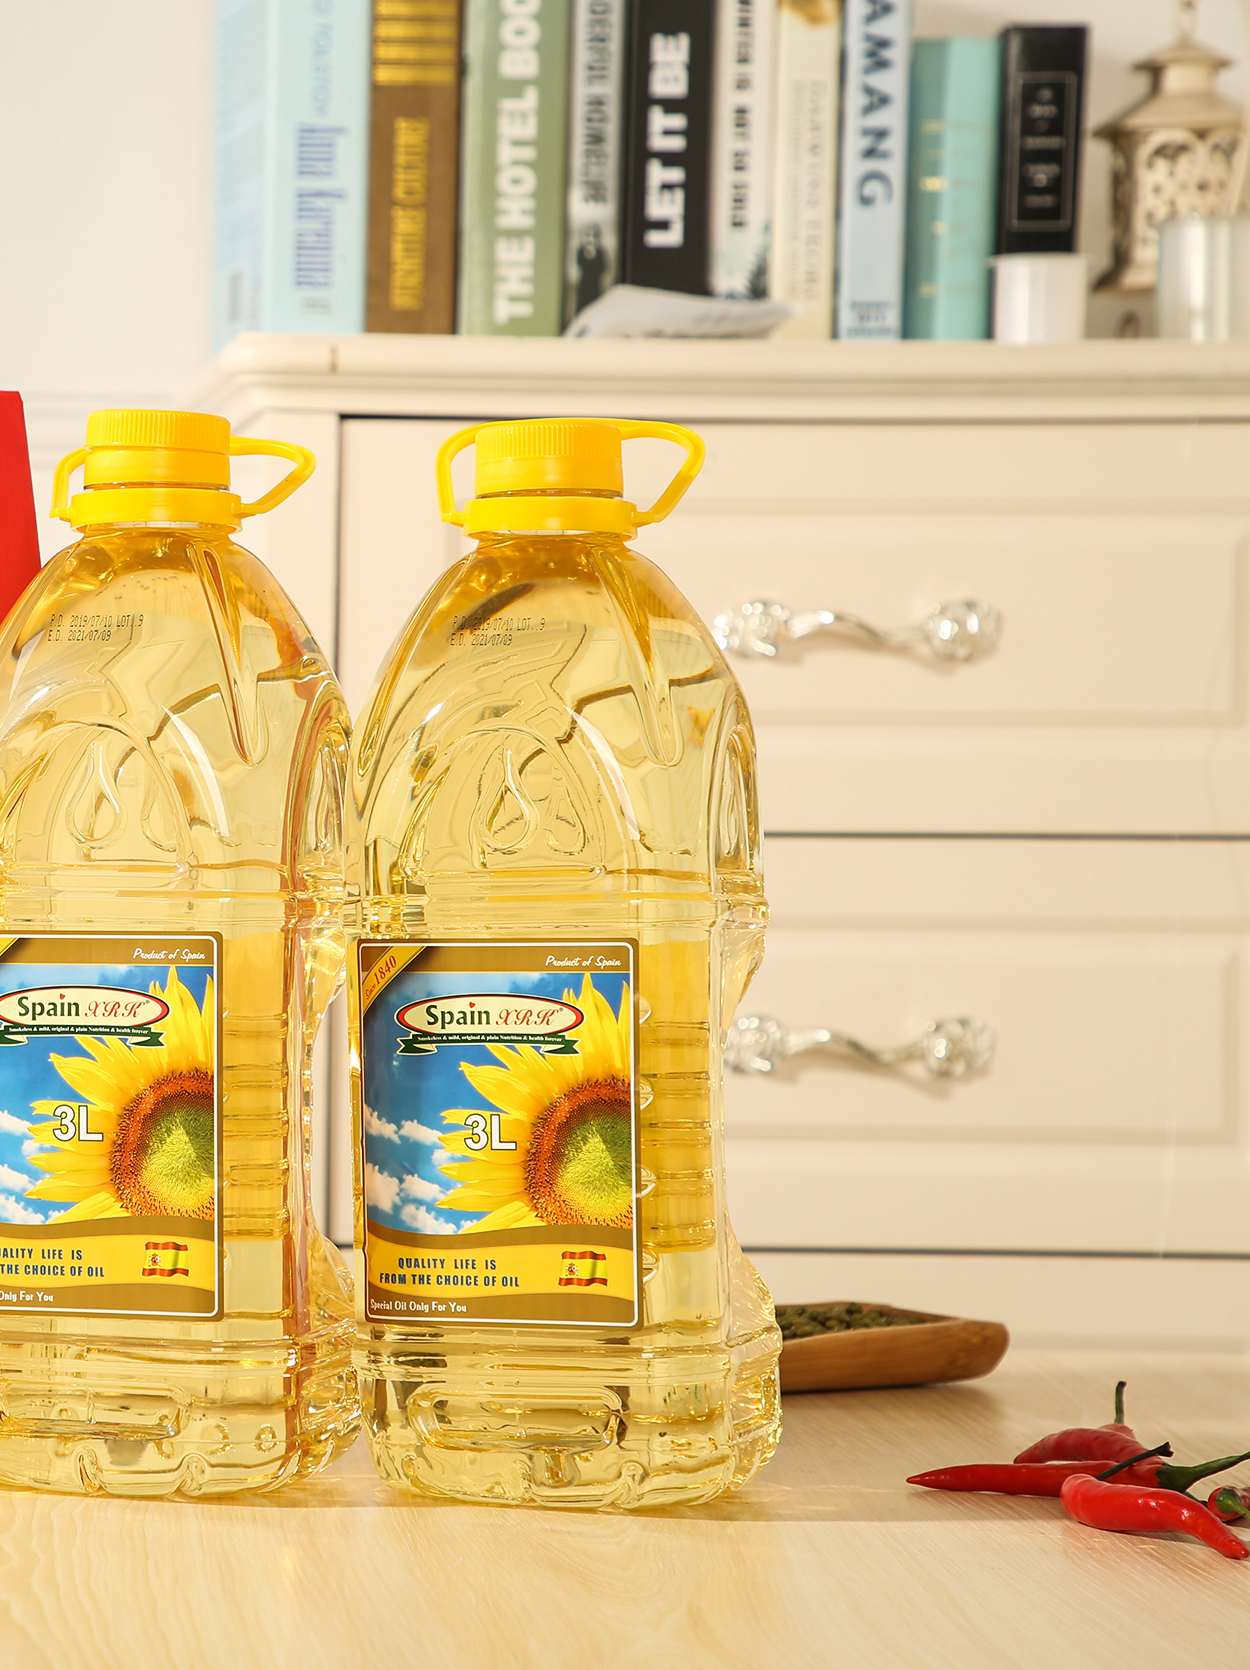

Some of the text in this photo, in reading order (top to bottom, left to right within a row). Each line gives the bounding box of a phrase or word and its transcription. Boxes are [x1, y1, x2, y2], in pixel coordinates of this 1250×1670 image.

[643, 31, 691, 248] LET IT BE
[495, 85, 539, 230] HOTEL
[493, 235, 535, 325] THE
[133, 948, 206, 963] Product of Spain
[545, 955, 622, 970] Product of Spain
[373, 954, 398, 985] 1840
[17, 993, 80, 1021] Spain
[425, 1002, 491, 1030] Spain
[52, 1105, 104, 1142] 3L
[463, 1114, 517, 1151] 3L
[41, 1248, 64, 1260] LIFE
[71, 1249, 83, 1261] IS
[398, 1257, 497, 1270] QUALITY LIFE IS
[0, 1263, 20, 1275] THE
[24, 1264, 66, 1276] CHOICE
[70, 1265, 83, 1277] OF
[87, 1266, 105, 1278] OIL
[379, 1272, 520, 1287] FROM THE CHOICE OF OIL
[19, 1290, 35, 1302] For
[36, 1291, 54, 1303] You
[370, 1298, 468, 1314] Special Oil Only For You
